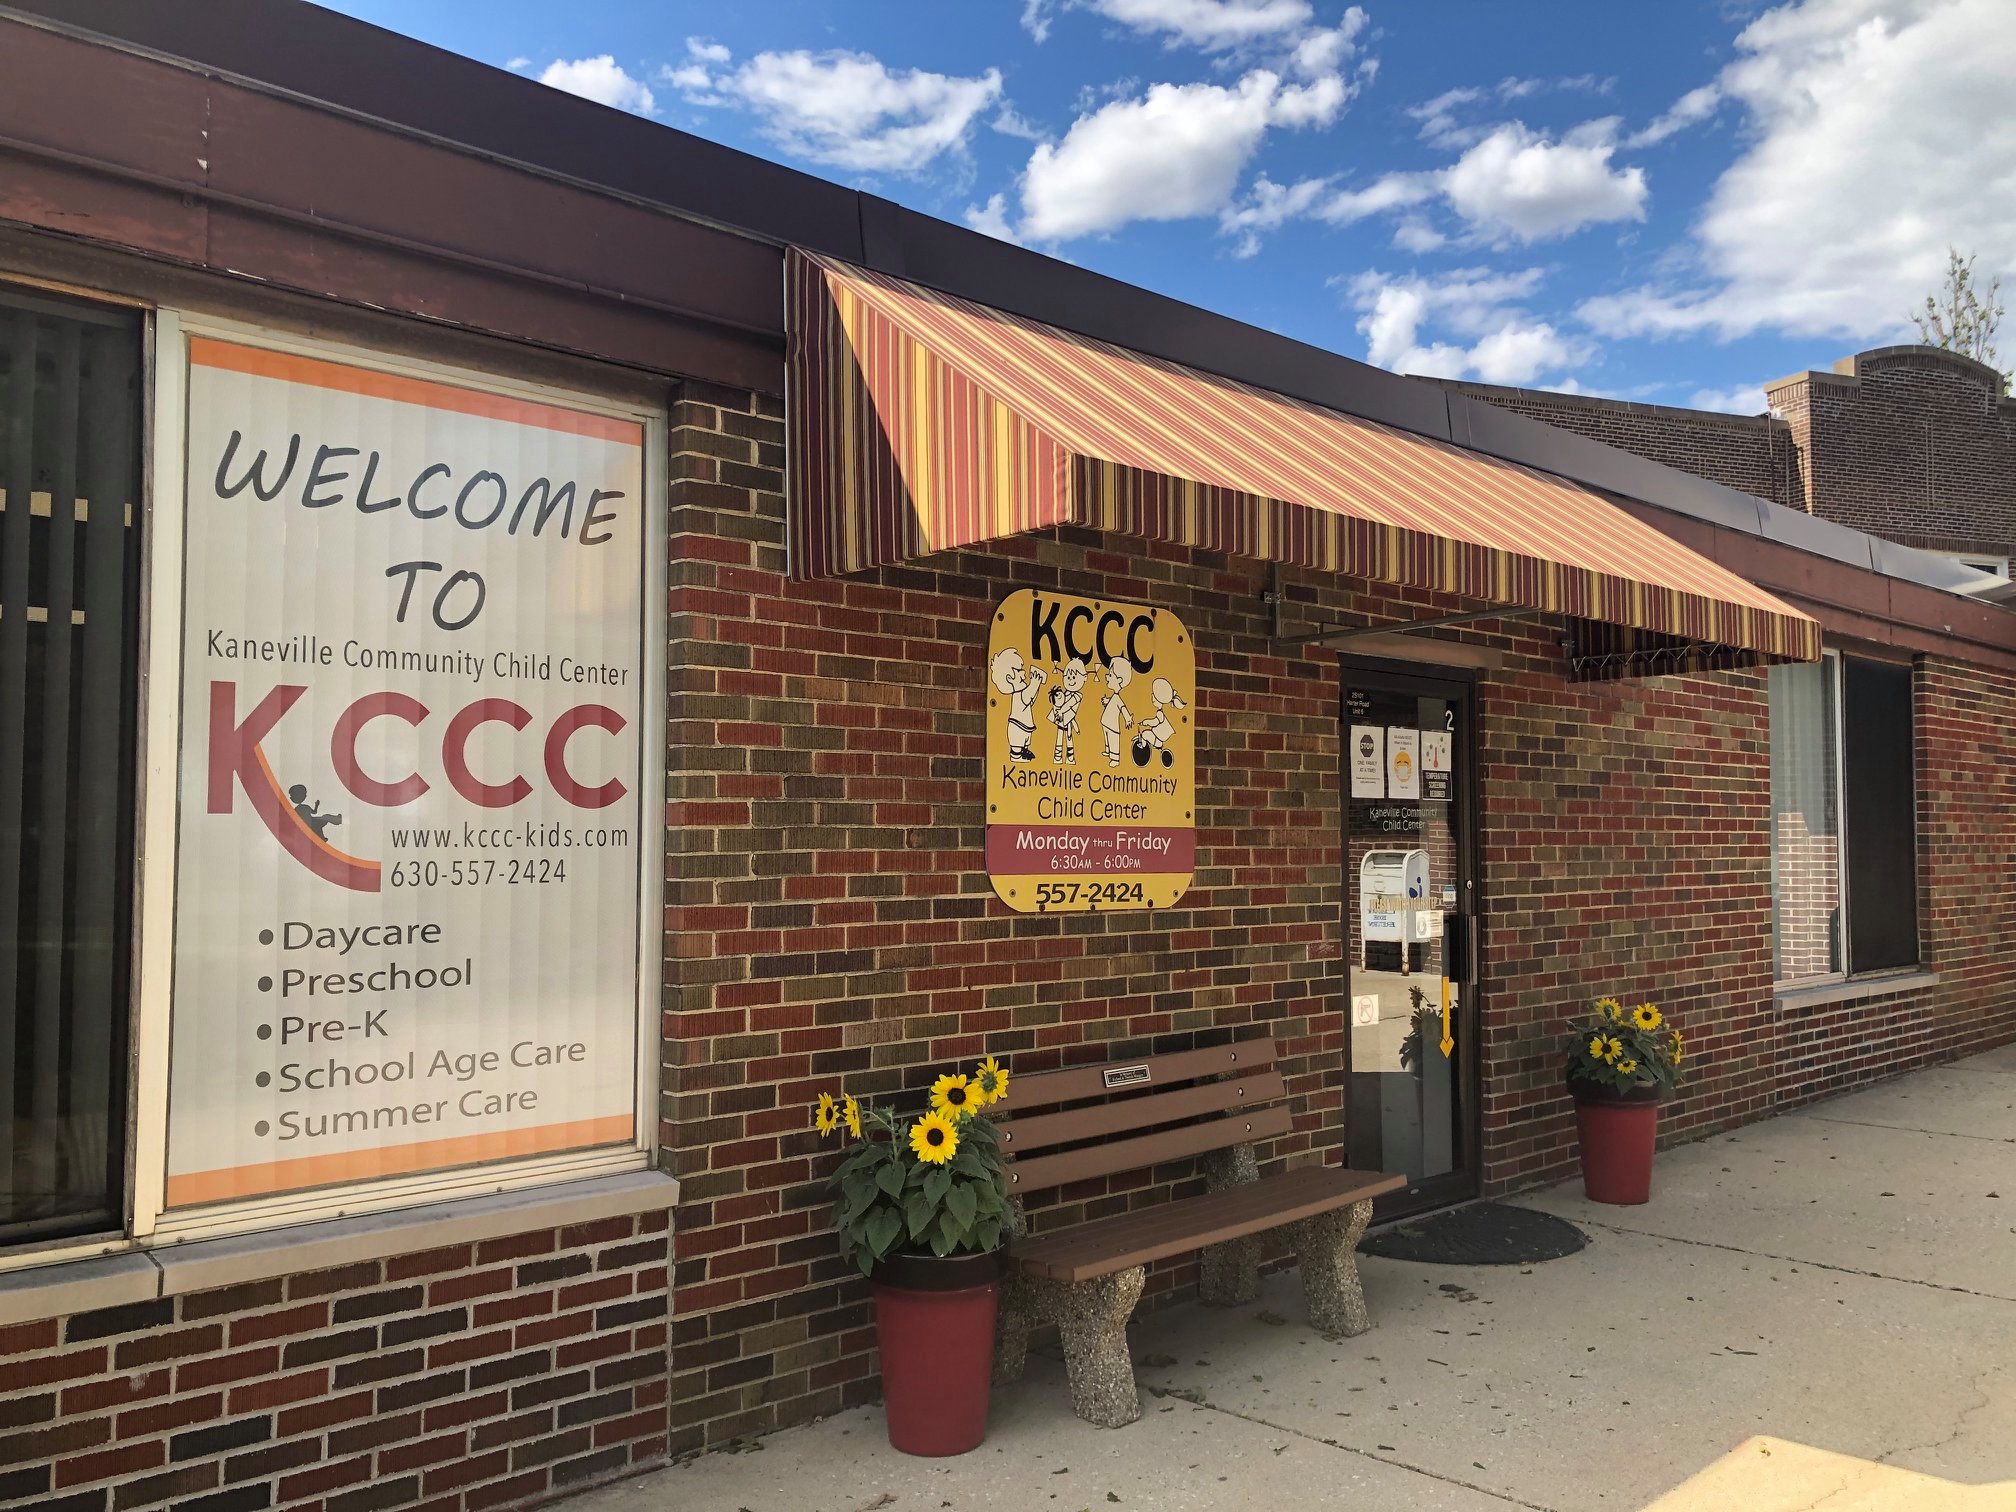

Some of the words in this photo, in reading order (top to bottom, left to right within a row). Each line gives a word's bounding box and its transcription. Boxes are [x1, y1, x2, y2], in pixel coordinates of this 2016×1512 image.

[214, 430, 625, 546] WELCOME
[385, 561, 486, 631] TO
[1031, 598, 1155, 674] KCCC
[207, 629, 333, 665] Kaneville
[343, 640, 484, 683] Community
[493, 652, 551, 682] Child
[560, 657, 629, 687] Center
[1445, 710, 1455, 731] 2
[1360, 742, 1374, 750] STOP
[207, 680, 628, 892] KCCC
[1001, 764, 1083, 790] Kaneville
[1088, 770, 1178, 796] Community
[1038, 796, 1085, 820] Child
[1090, 798, 1148, 822] Center
[1369, 807, 1400, 819] Kaneville
[1401, 807, 1438, 818] Community
[1382, 820, 1400, 831] Child
[1402, 819, 1426, 831] Center
[391, 822, 628, 849] www.kccc-kids.com
[1015, 830, 1091, 855] Monday
[1093, 837, 1113, 848] thru
[1116, 831, 1172, 855] Friday
[390, 859, 566, 888] 630-557-2424
[1050, 854, 1092, 869] 6:30AM
[1103, 854, 1141, 869] 6:00PM
[1035, 882, 1144, 904] 557-2424
[282, 920, 442, 956] Daycare
[281, 958, 473, 998] Preschool
[280, 1010, 389, 1045] Pre-K
[278, 1051, 415, 1094] School
[427, 1048, 501, 1082] Age
[510, 1040, 587, 1067] Care
[277, 1099, 448, 1141] Summer
[458, 1089, 538, 1118] Care
